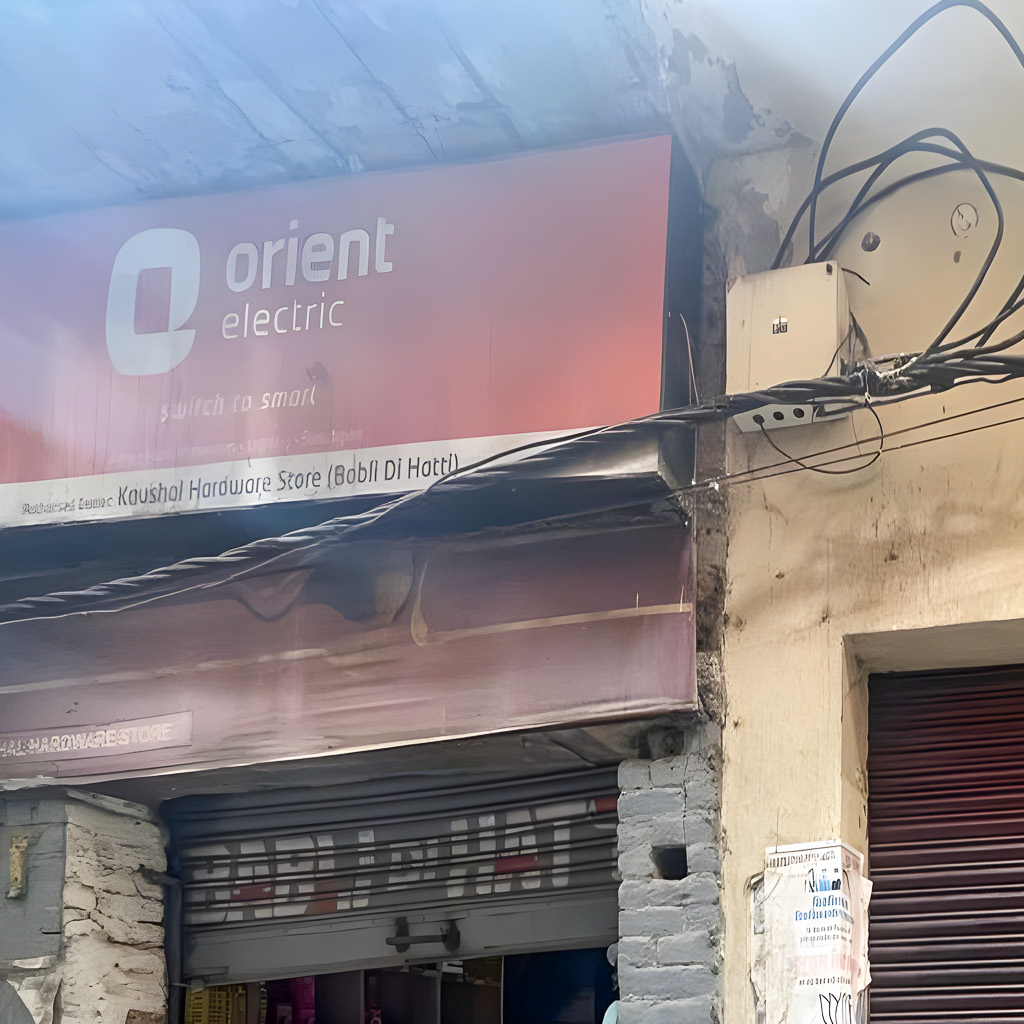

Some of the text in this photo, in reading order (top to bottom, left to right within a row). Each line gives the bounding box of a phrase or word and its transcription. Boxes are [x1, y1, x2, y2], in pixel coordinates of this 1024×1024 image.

[226, 217, 395, 293] orient
[222, 291, 345, 339] electric
[261, 385, 316, 410] smart
[189, 476, 271, 500] Hardware
[277, 470, 322, 492] Store
[384, 458, 402, 481] Di
[117, 723, 174, 745] STORE
